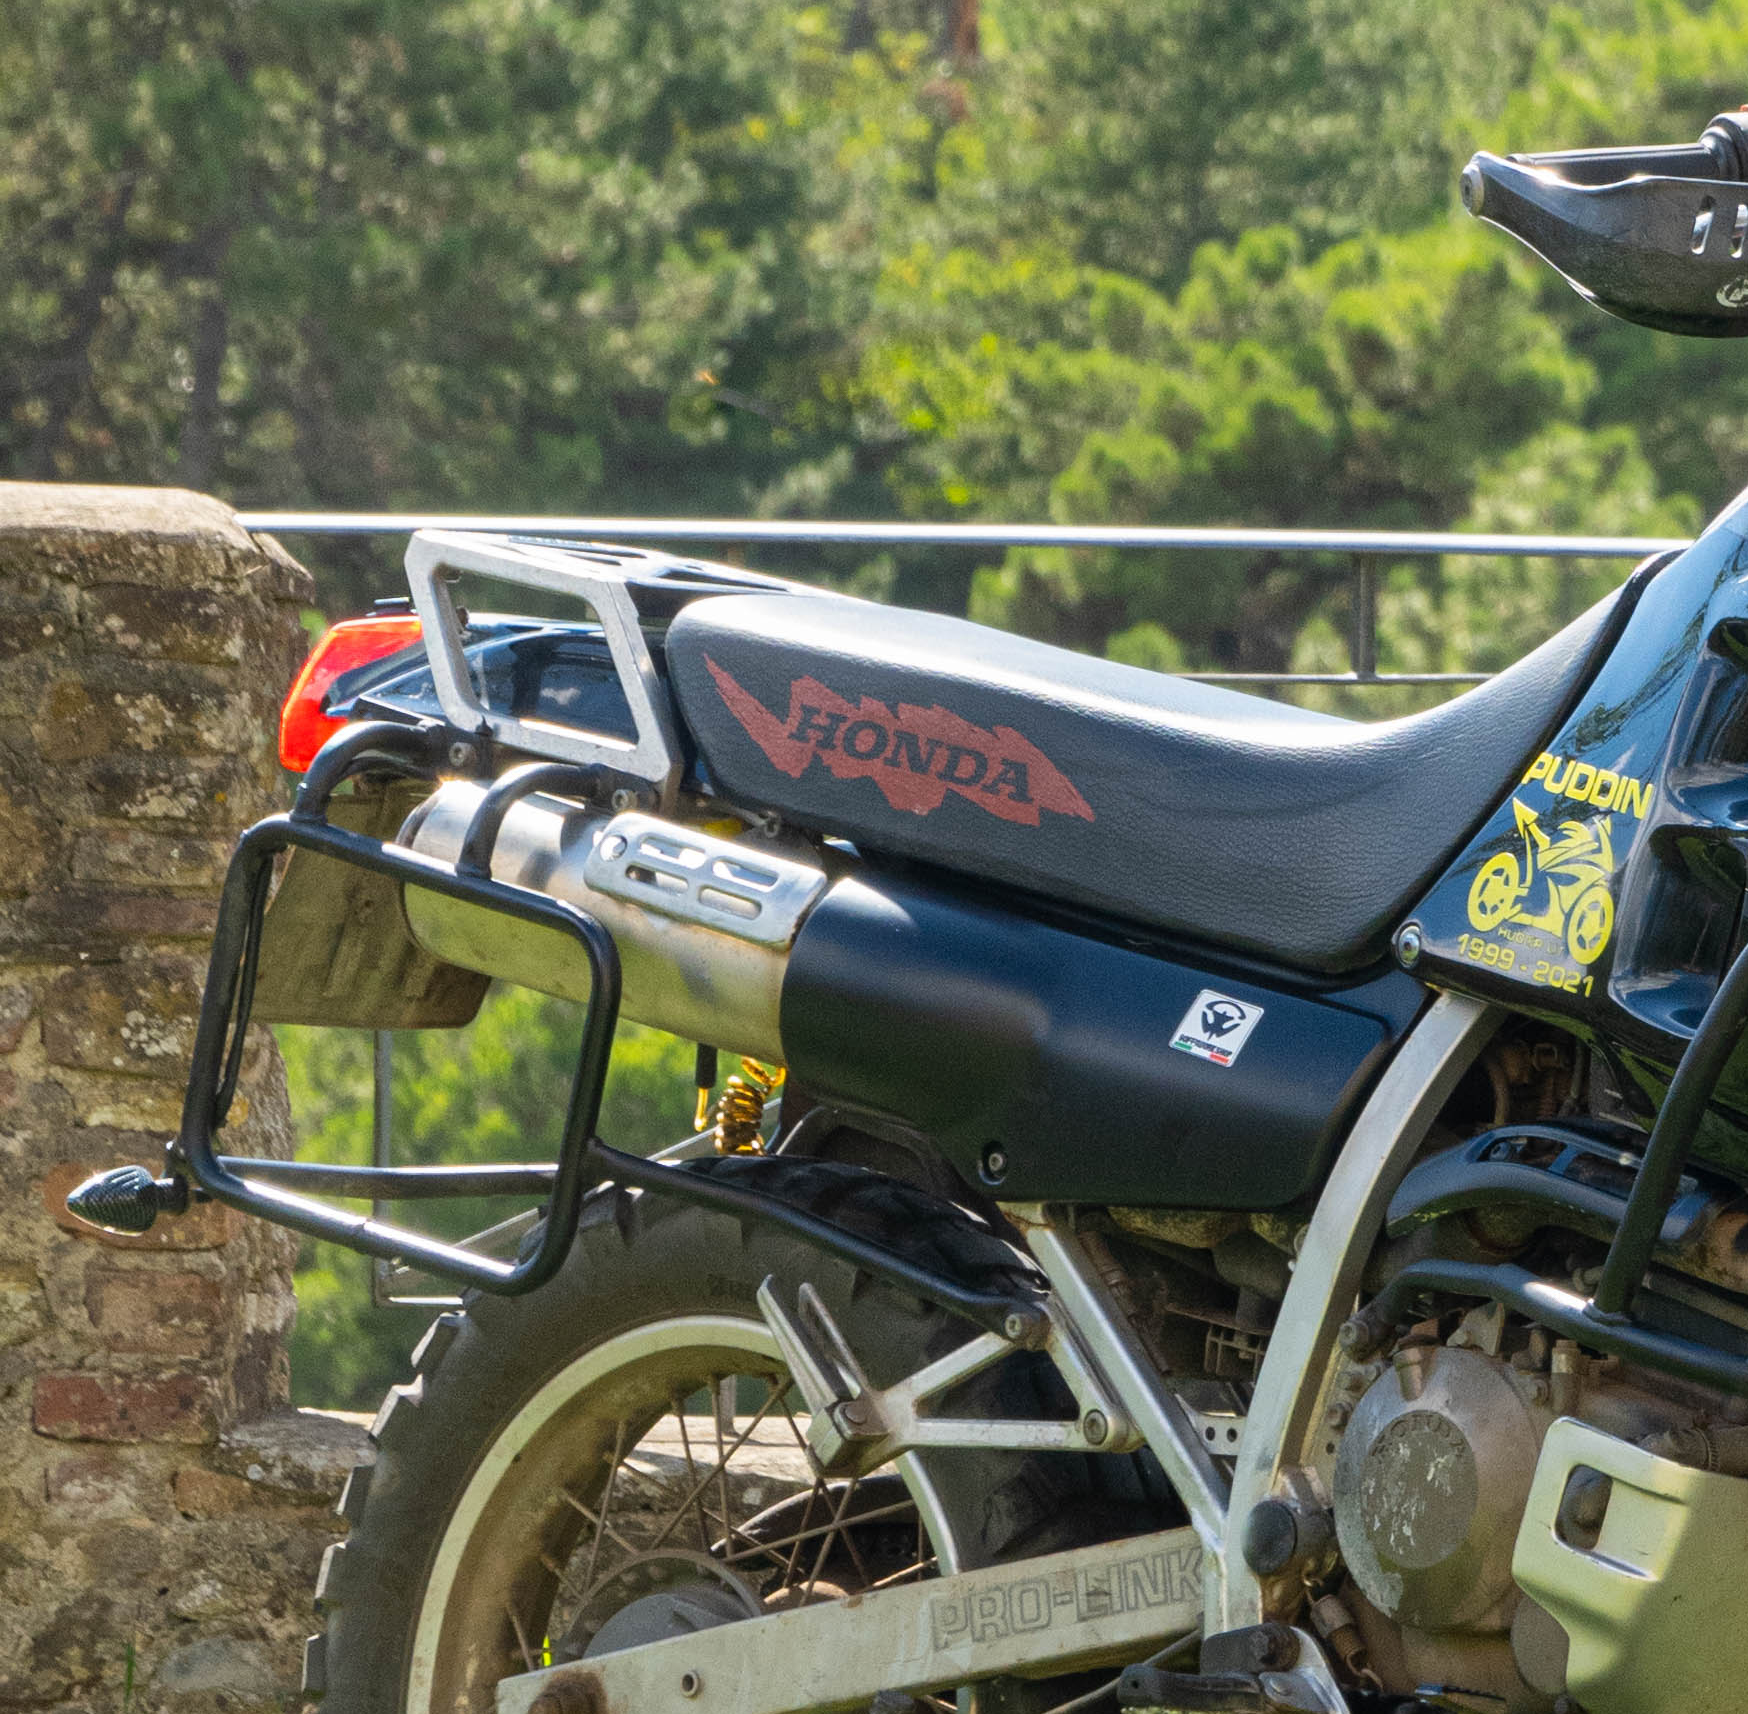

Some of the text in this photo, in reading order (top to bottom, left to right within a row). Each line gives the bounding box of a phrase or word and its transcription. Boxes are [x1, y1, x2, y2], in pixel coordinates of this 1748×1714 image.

[787, 703, 1037, 805] HONDA
[1520, 751, 1655, 820] PUDDIN
[1457, 932, 1516, 972] 1999
[1531, 960, 1595, 998] 2021
[929, 1545, 1204, 1653] PRO-LINK
